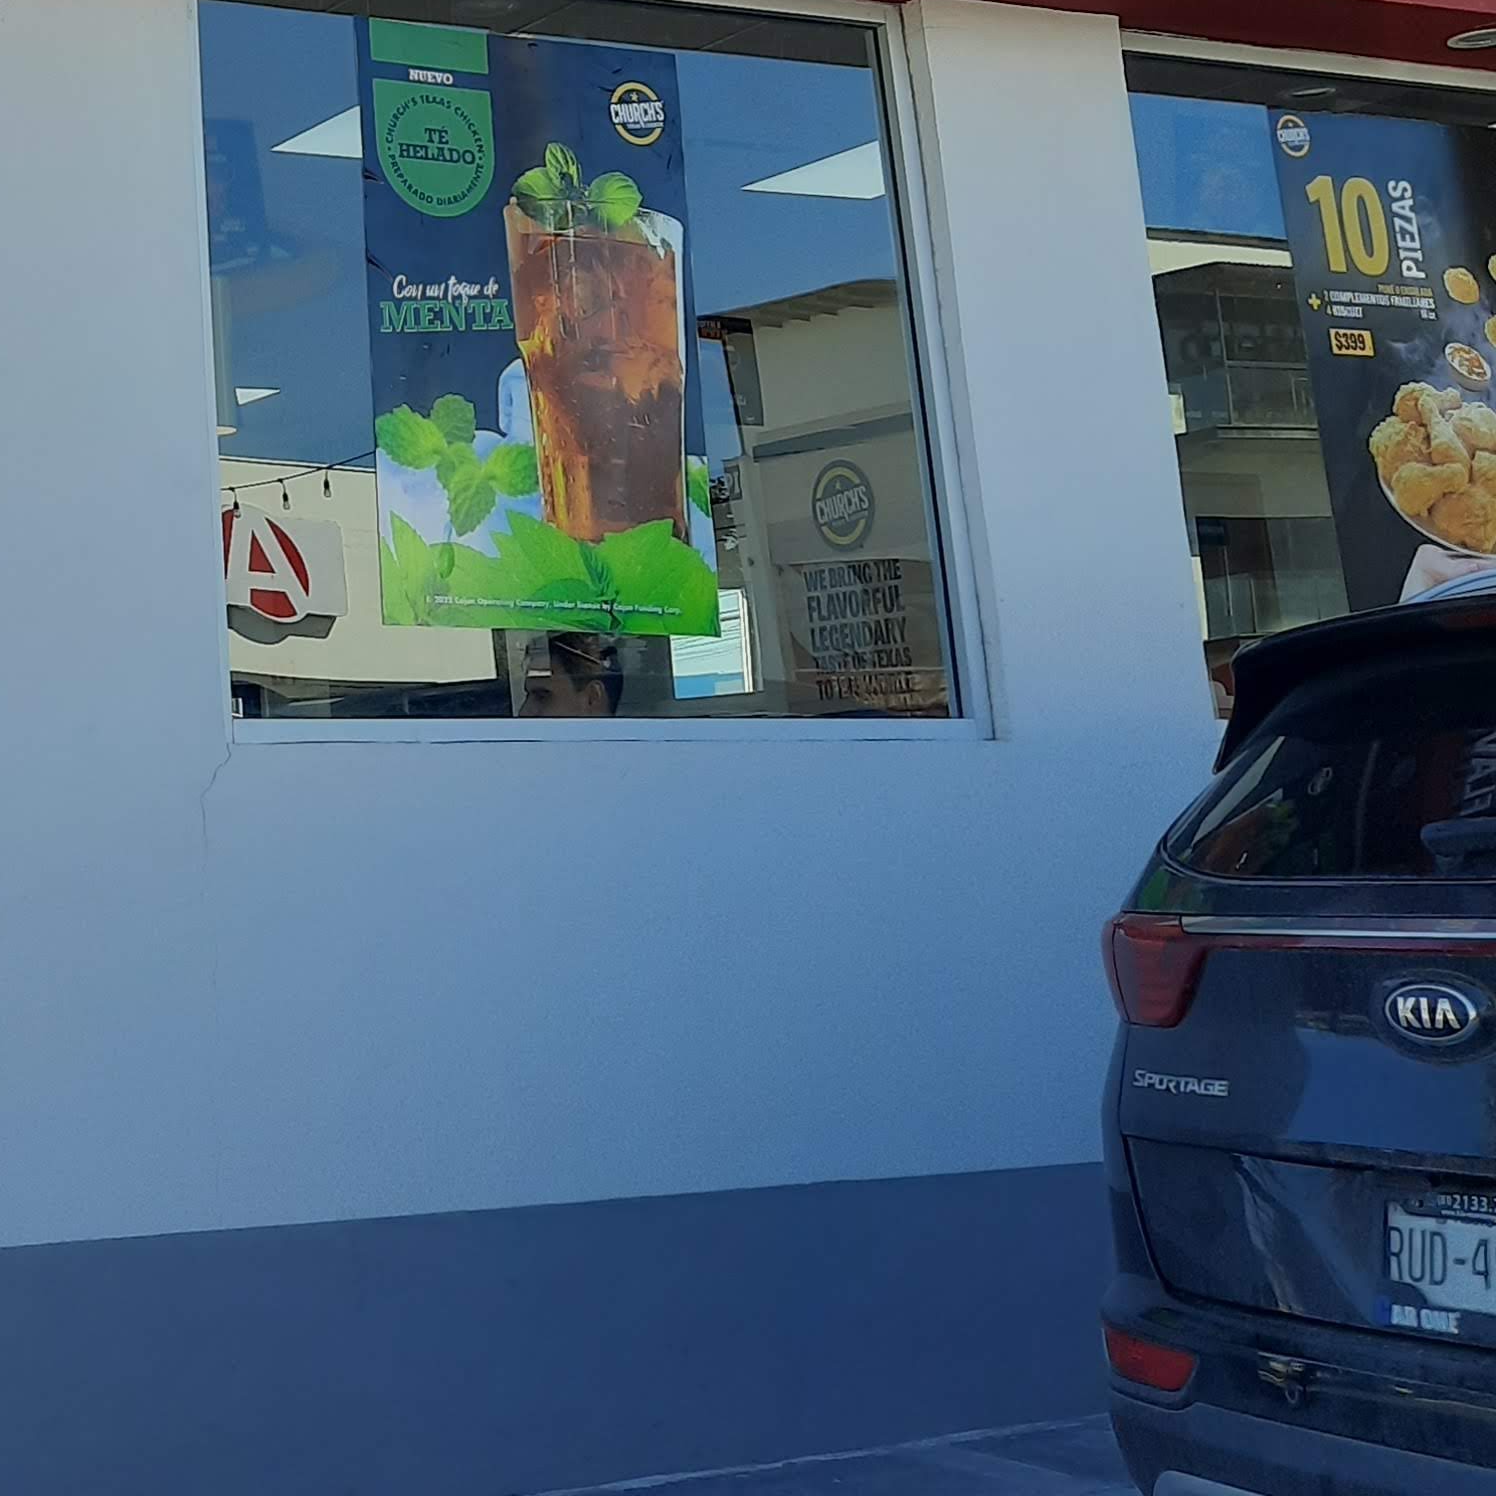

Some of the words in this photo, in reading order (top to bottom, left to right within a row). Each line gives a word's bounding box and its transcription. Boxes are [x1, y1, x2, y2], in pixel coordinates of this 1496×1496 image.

[408, 68, 453, 84] NUEVO
[419, 94, 452, 110] TEXAS
[454, 106, 485, 157] CHICKEN
[610, 101, 664, 125] CHURCH'S
[424, 126, 449, 144] TÉ
[398, 142, 476, 165] HELADO
[388, 154, 434, 204] PREPARADO
[436, 163, 485, 206] DIARIAMENTE
[1305, 175, 1390, 276] 10
[1387, 180, 1426, 279] PIEZAS
[393, 274, 423, 300] Con
[426, 282, 446, 300] un
[447, 275, 481, 304] toque
[483, 276, 499, 299] de
[380, 299, 514, 333] MENTA
[1334, 331, 1366, 351] $399
[816, 485, 869, 524] CHURCH'S
[804, 568, 829, 594] WE
[829, 562, 873, 589] BRING
[874, 559, 902, 583] THE
[807, 585, 906, 623] FLAVORFUL
[810, 616, 907, 653] LEGENDARY
[1395, 997, 1462, 1030] KIA
[1133, 1069, 1230, 1097] SPORTAGE
[1388, 1225, 1496, 1289] RUD-4
